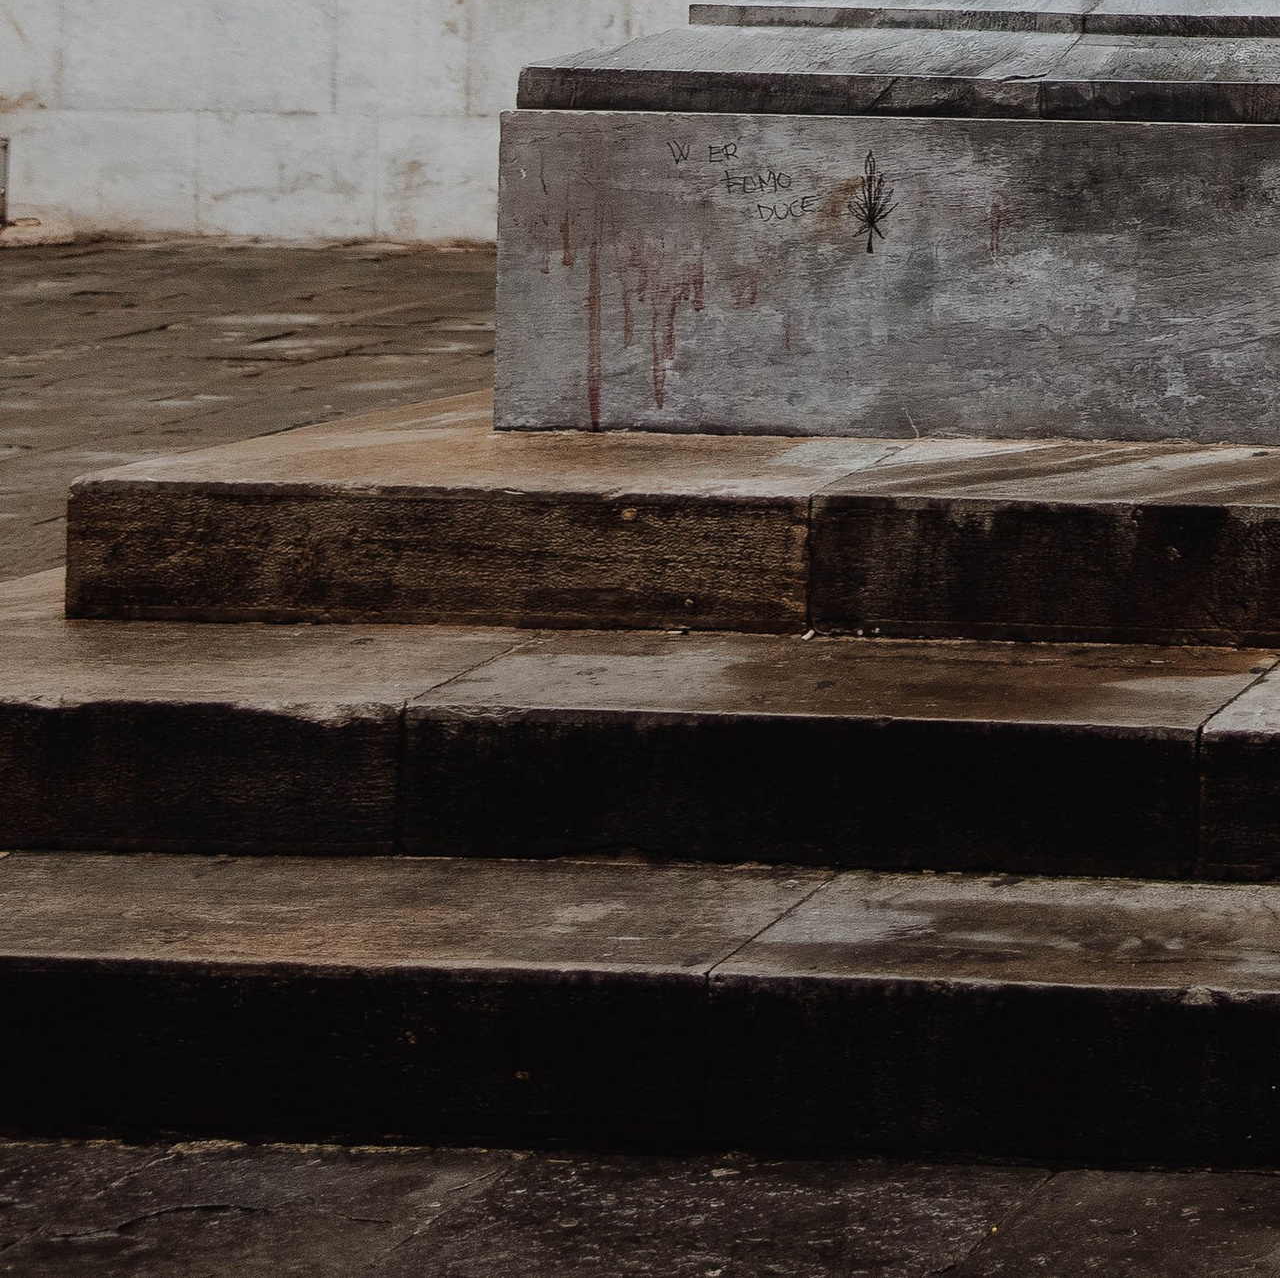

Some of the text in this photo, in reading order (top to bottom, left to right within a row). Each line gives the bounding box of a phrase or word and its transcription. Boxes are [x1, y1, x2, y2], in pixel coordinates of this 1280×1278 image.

[667, 140, 739, 165] W ER
[756, 195, 817, 223] DUCE
